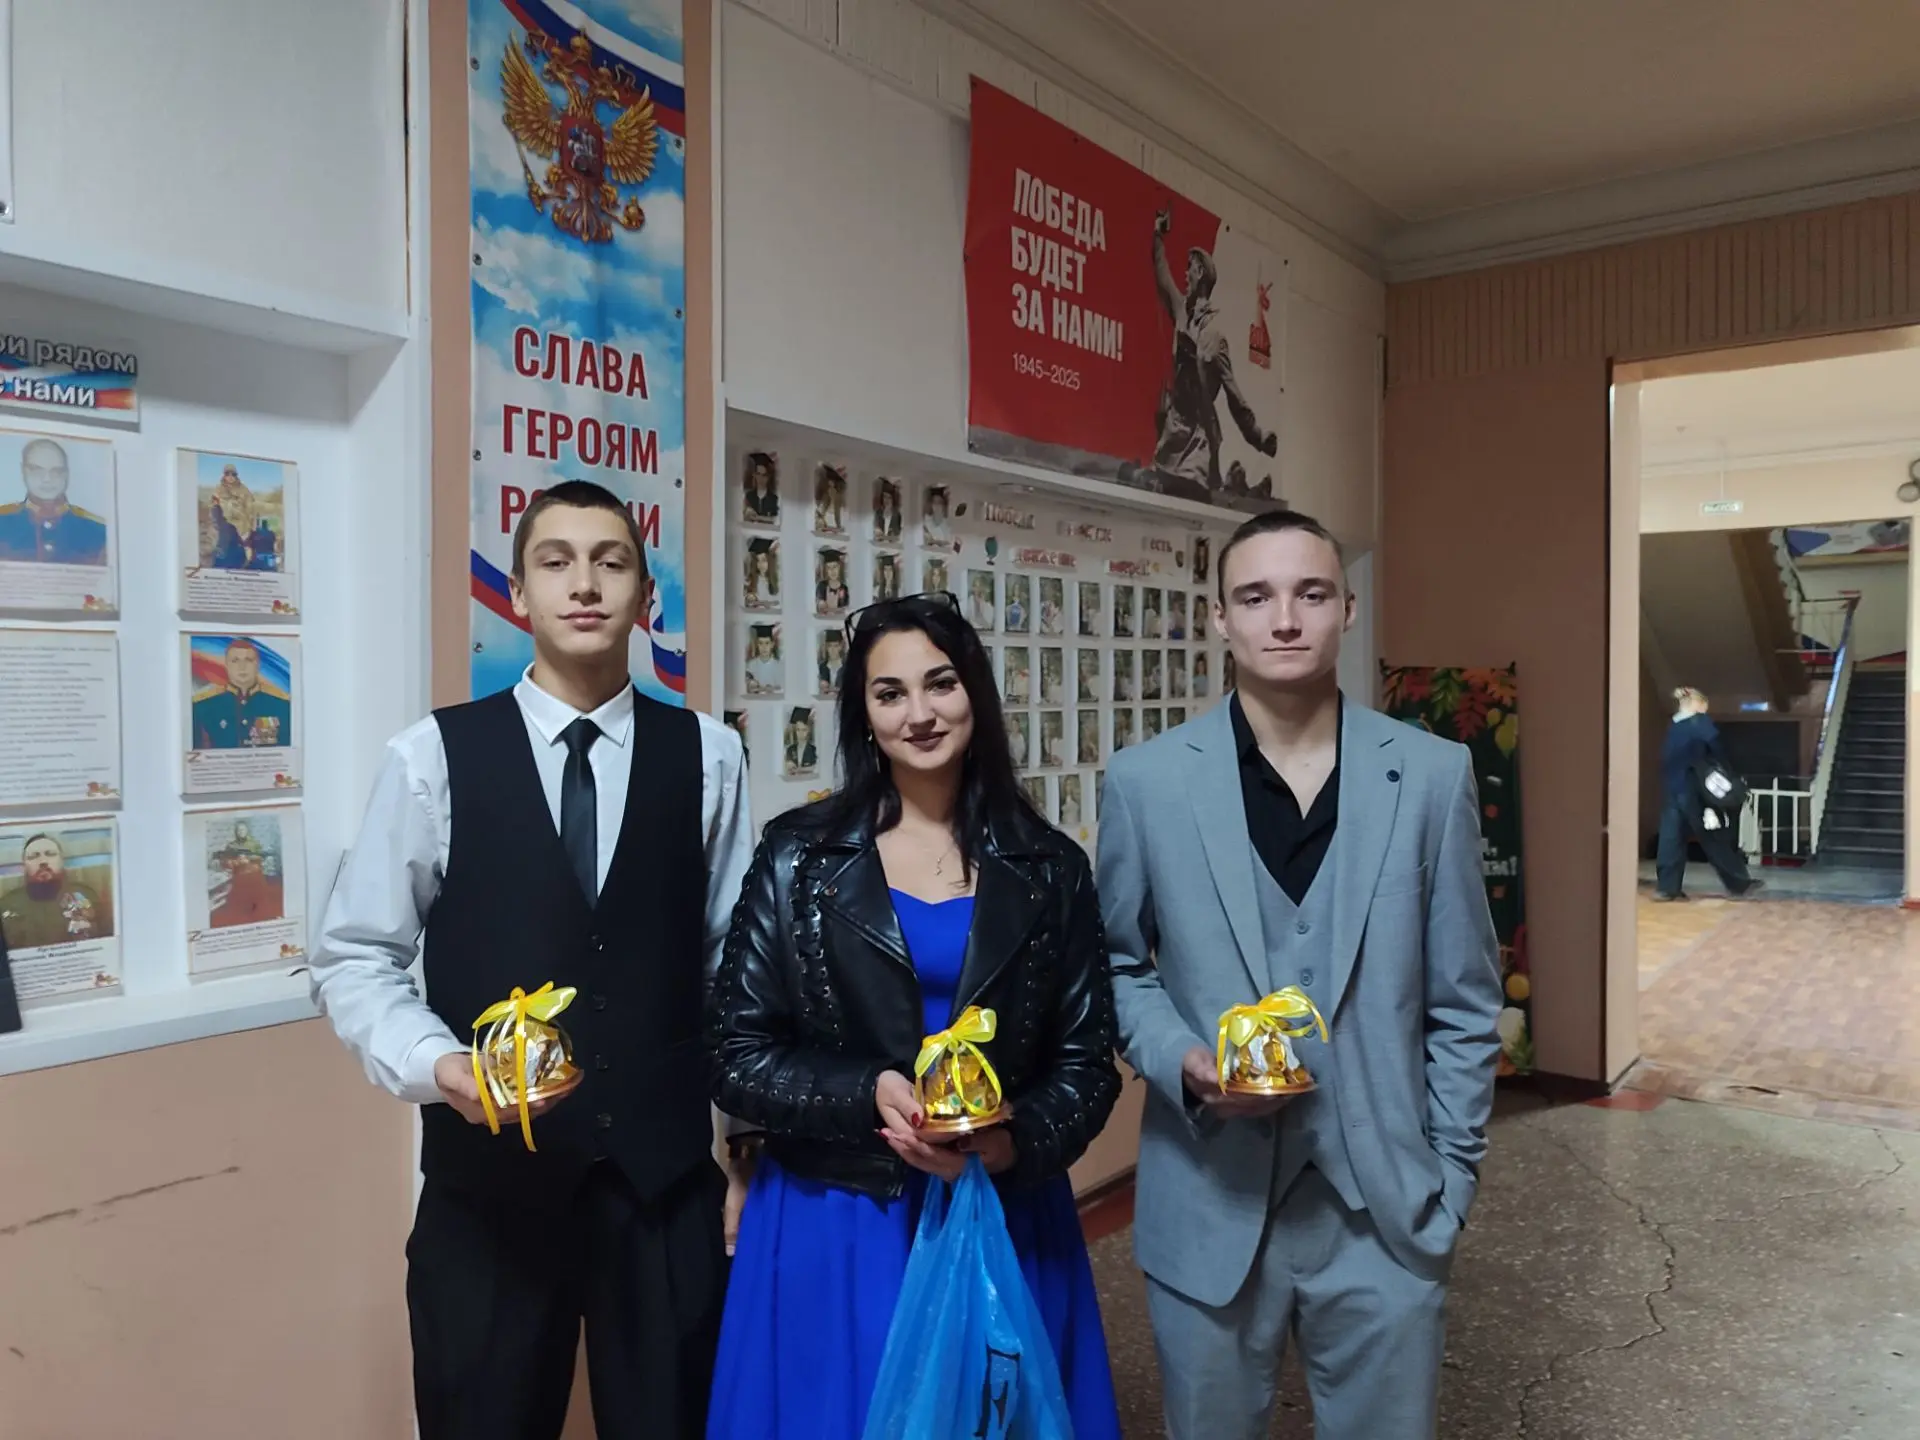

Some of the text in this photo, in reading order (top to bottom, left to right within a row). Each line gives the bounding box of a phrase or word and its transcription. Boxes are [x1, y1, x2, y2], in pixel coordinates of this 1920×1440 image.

[1013, 167, 1107, 252] ПОБЕДА
[1011, 225, 1087, 293] БУДЕТ
[36, 340, 137, 374] рядом
[1012, 283, 1123, 362] ЗА НАМИ!
[13, 377, 96, 408] нами
[514, 326, 648, 401] СЛАВА
[503, 403, 658, 475] ГЕРОЯМ
